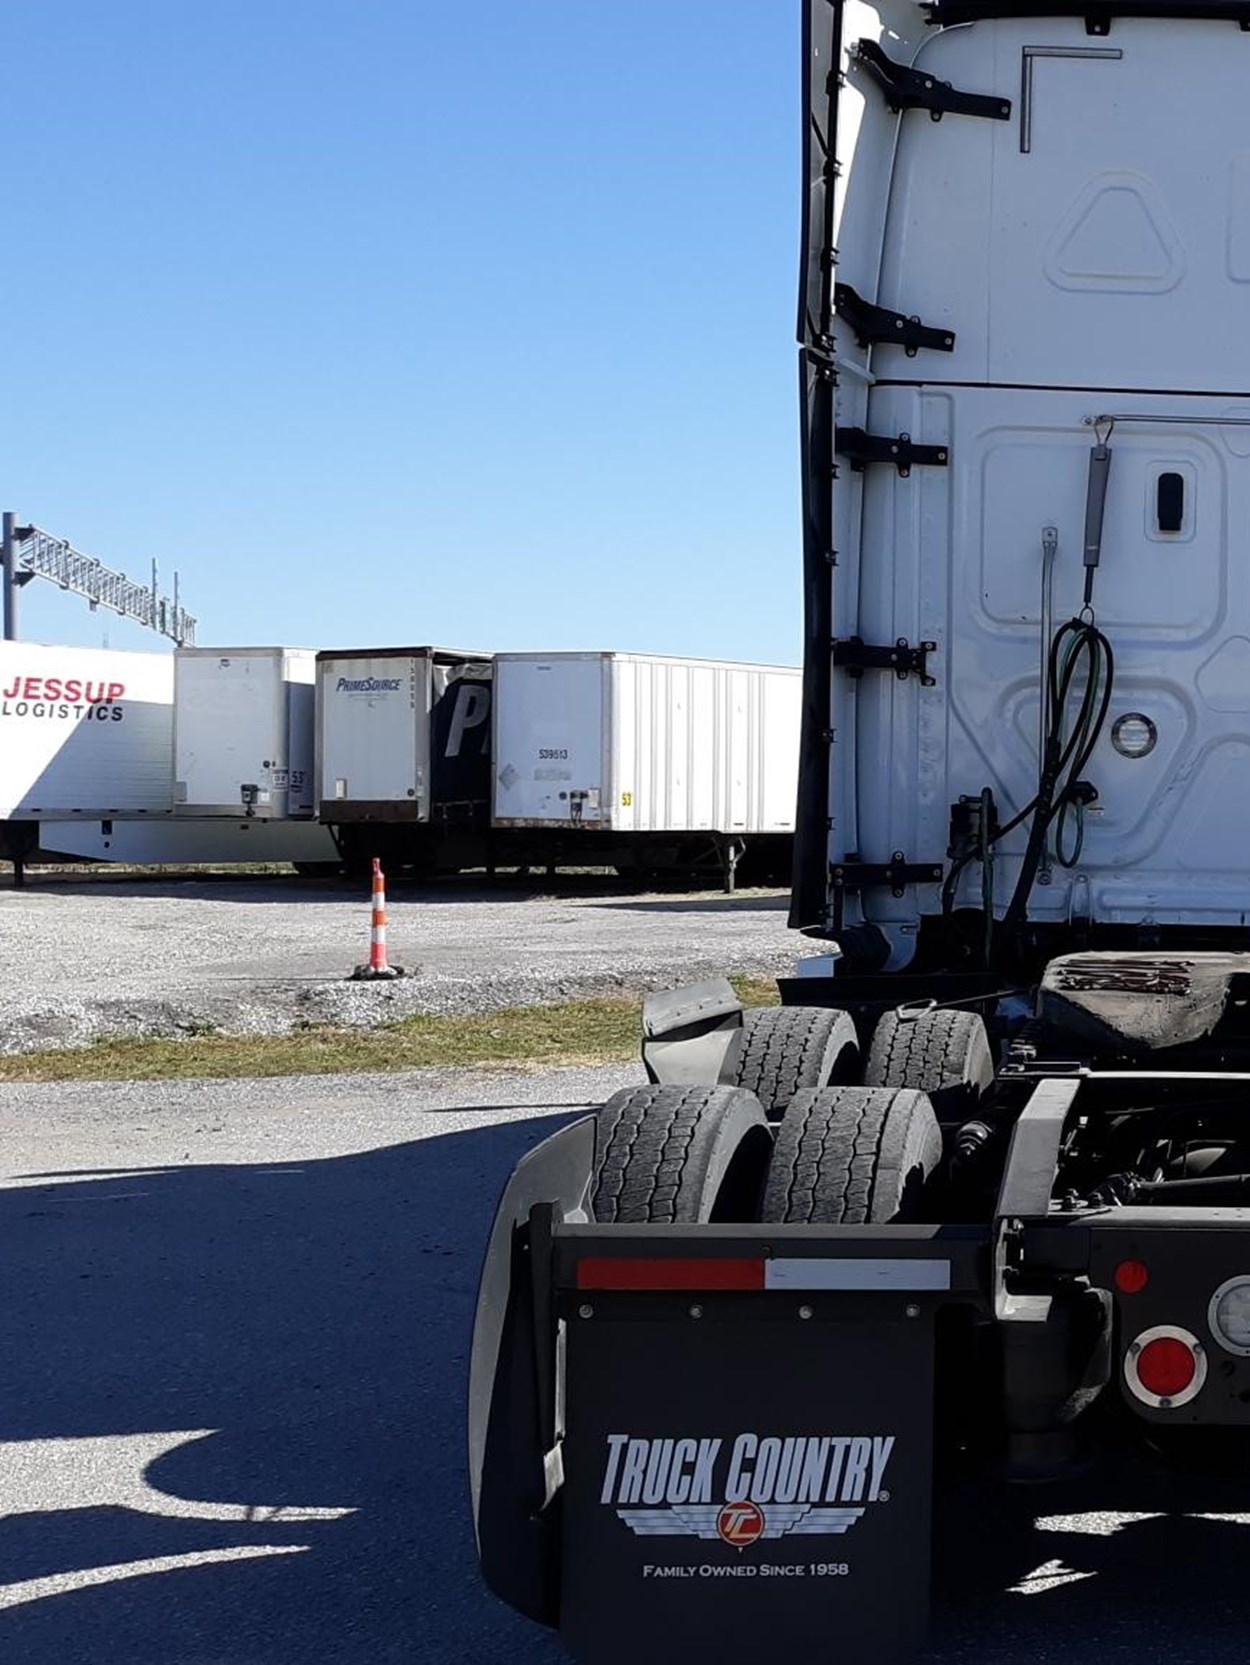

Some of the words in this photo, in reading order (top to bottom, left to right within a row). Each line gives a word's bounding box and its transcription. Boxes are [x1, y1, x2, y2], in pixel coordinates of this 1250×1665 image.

[3, 675, 126, 705] JESSUP
[2, 701, 124, 722] LOGISTICS
[600, 1434, 722, 1505] TRUCK
[643, 1564, 698, 1577] FAMILY
[699, 1564, 757, 1577] OWNED
[759, 1564, 805, 1576] SINCE
[809, 1563, 849, 1576] 1958
